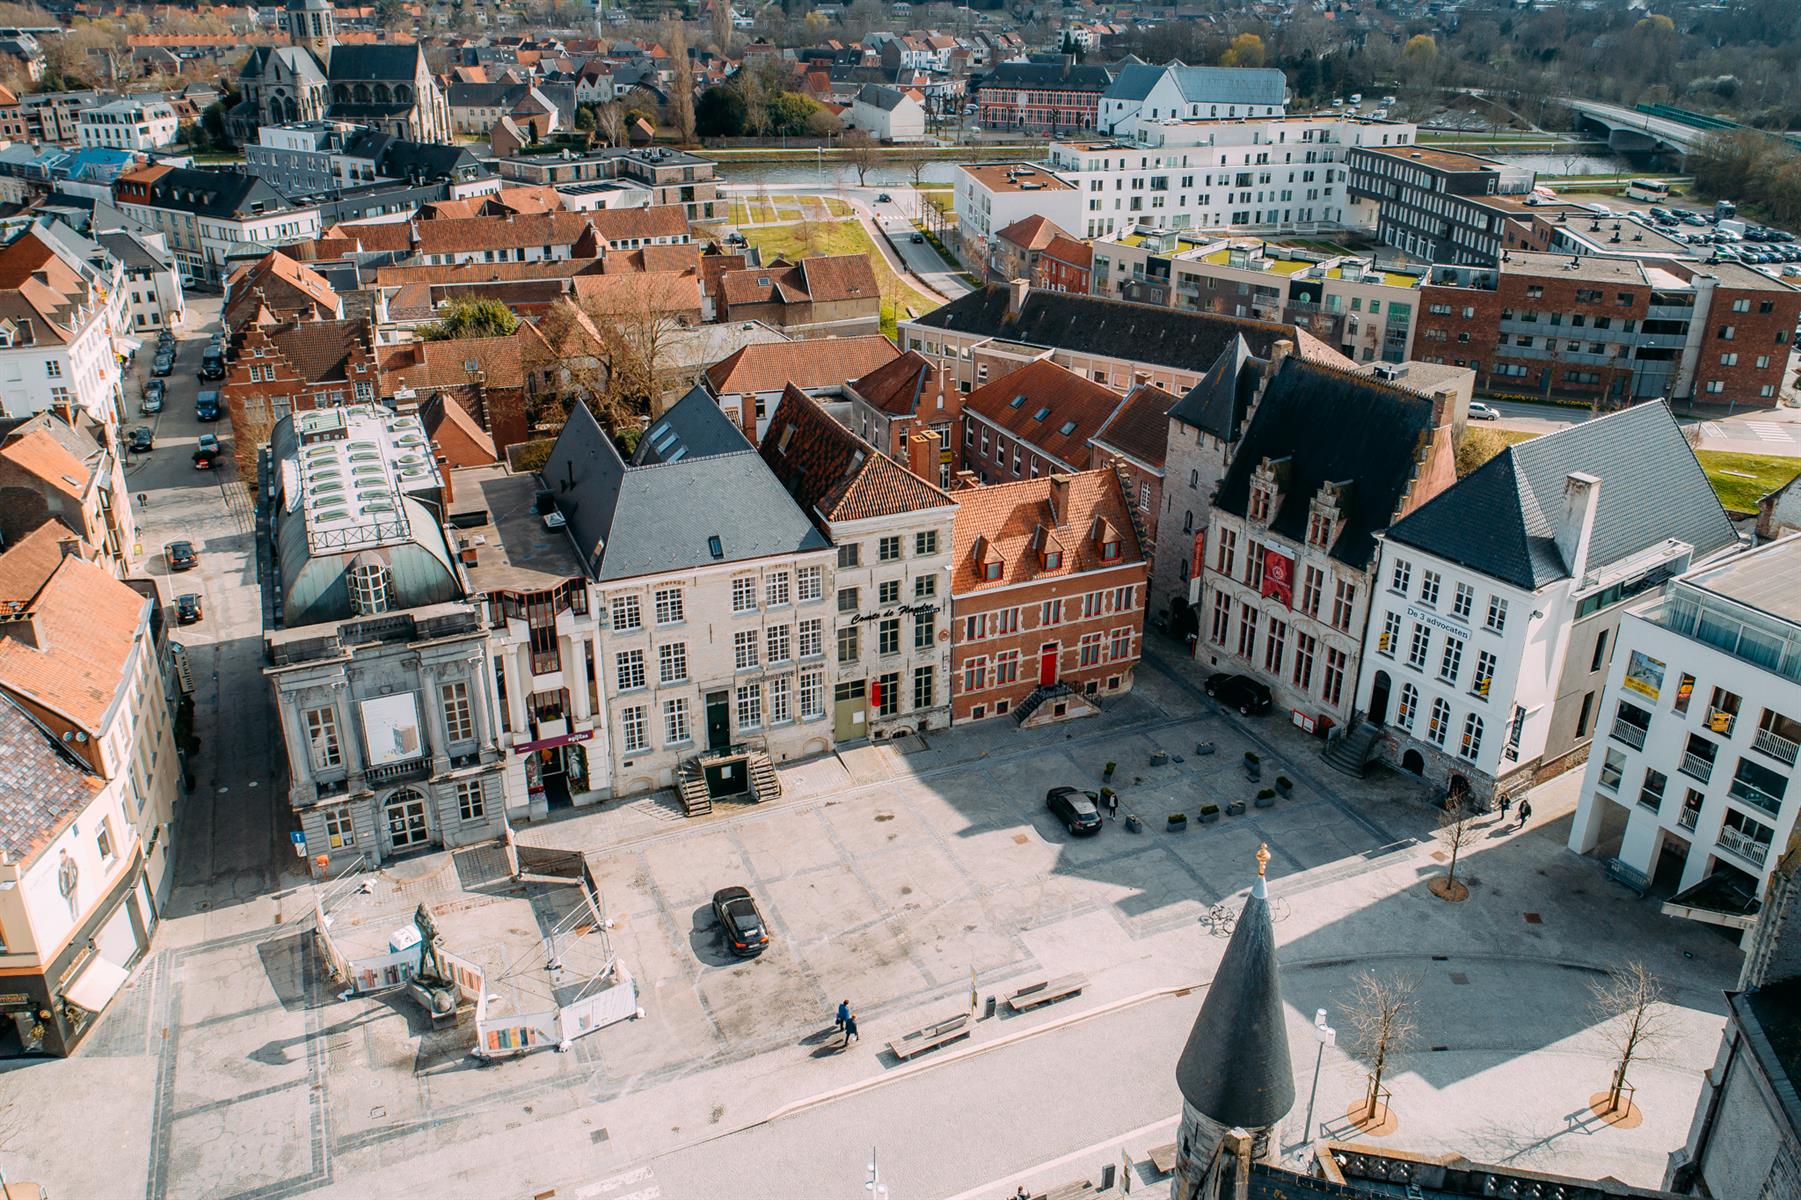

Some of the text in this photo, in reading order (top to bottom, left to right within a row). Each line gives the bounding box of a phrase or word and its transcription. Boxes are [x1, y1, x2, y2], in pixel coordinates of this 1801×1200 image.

[883, 609, 895, 617] de
[1407, 607, 1419, 617] De
[1426, 617, 1468, 639] advocaten
